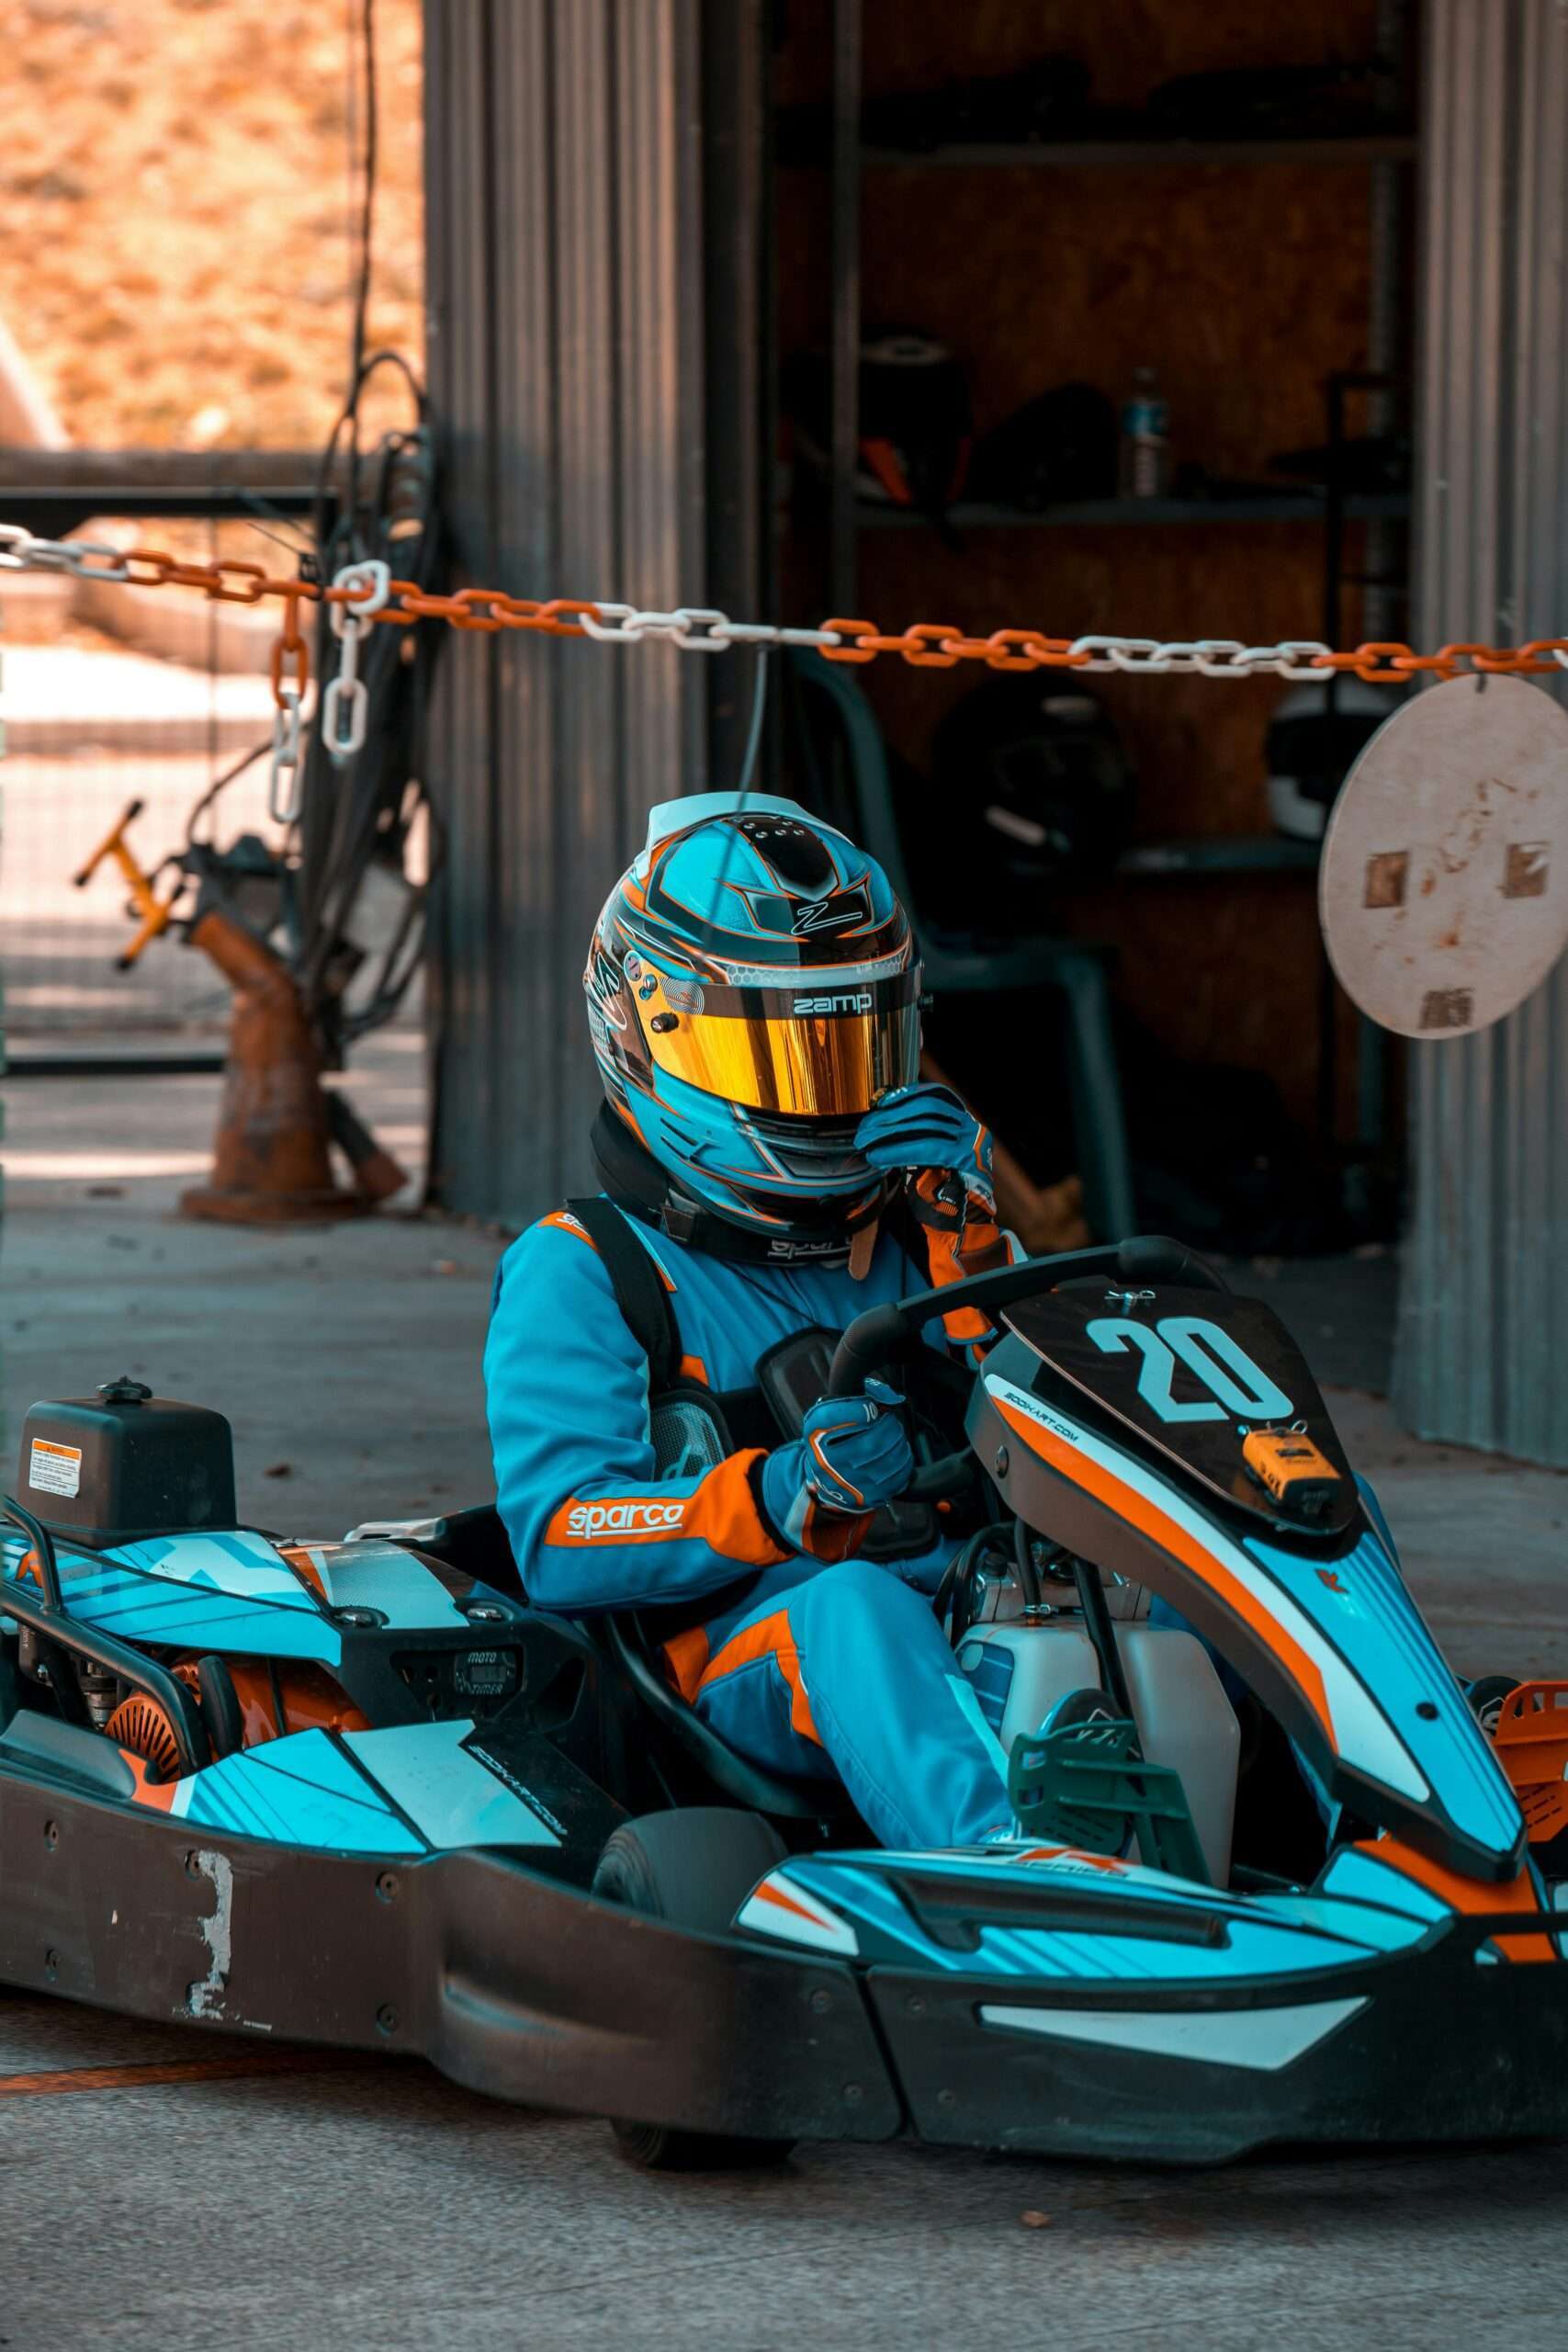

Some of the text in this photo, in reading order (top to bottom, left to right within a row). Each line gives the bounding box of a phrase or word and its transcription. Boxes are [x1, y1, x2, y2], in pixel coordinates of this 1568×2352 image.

[794, 993, 872, 1014] zamp
[1086, 1316, 1294, 1423] 20
[566, 1504, 684, 1540] sparco
